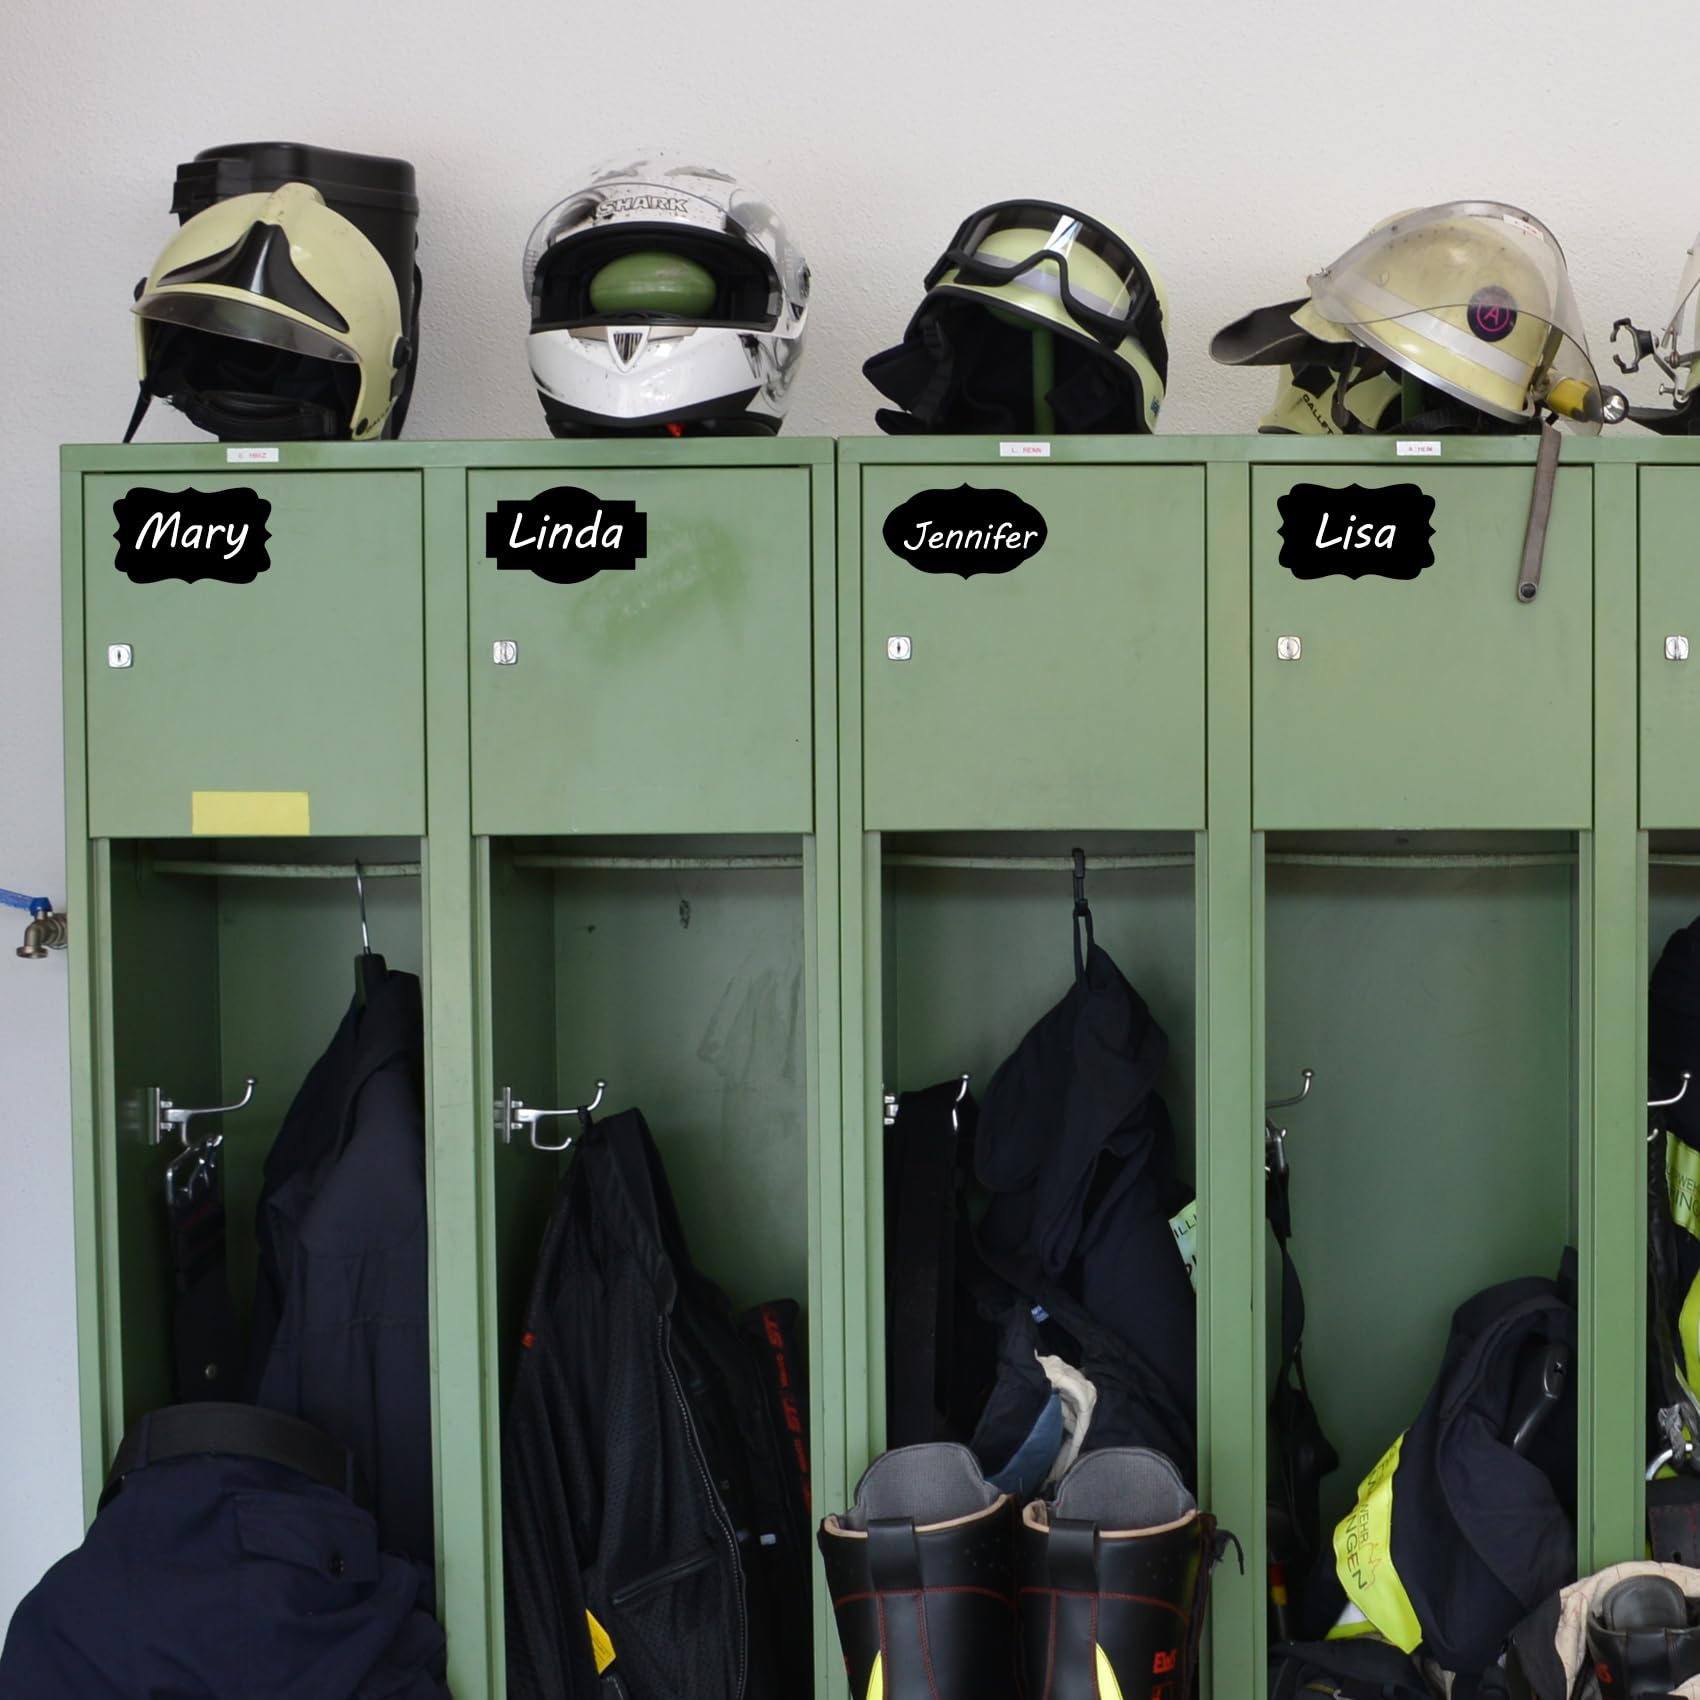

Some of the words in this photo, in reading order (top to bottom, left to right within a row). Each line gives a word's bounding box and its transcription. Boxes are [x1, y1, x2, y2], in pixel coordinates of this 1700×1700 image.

[596, 195, 688, 217] SHARK
[134, 510, 249, 560] Mary
[508, 509, 624, 551] Linda
[903, 520, 1039, 551] Jennifer
[1315, 512, 1397, 550] Lisa
